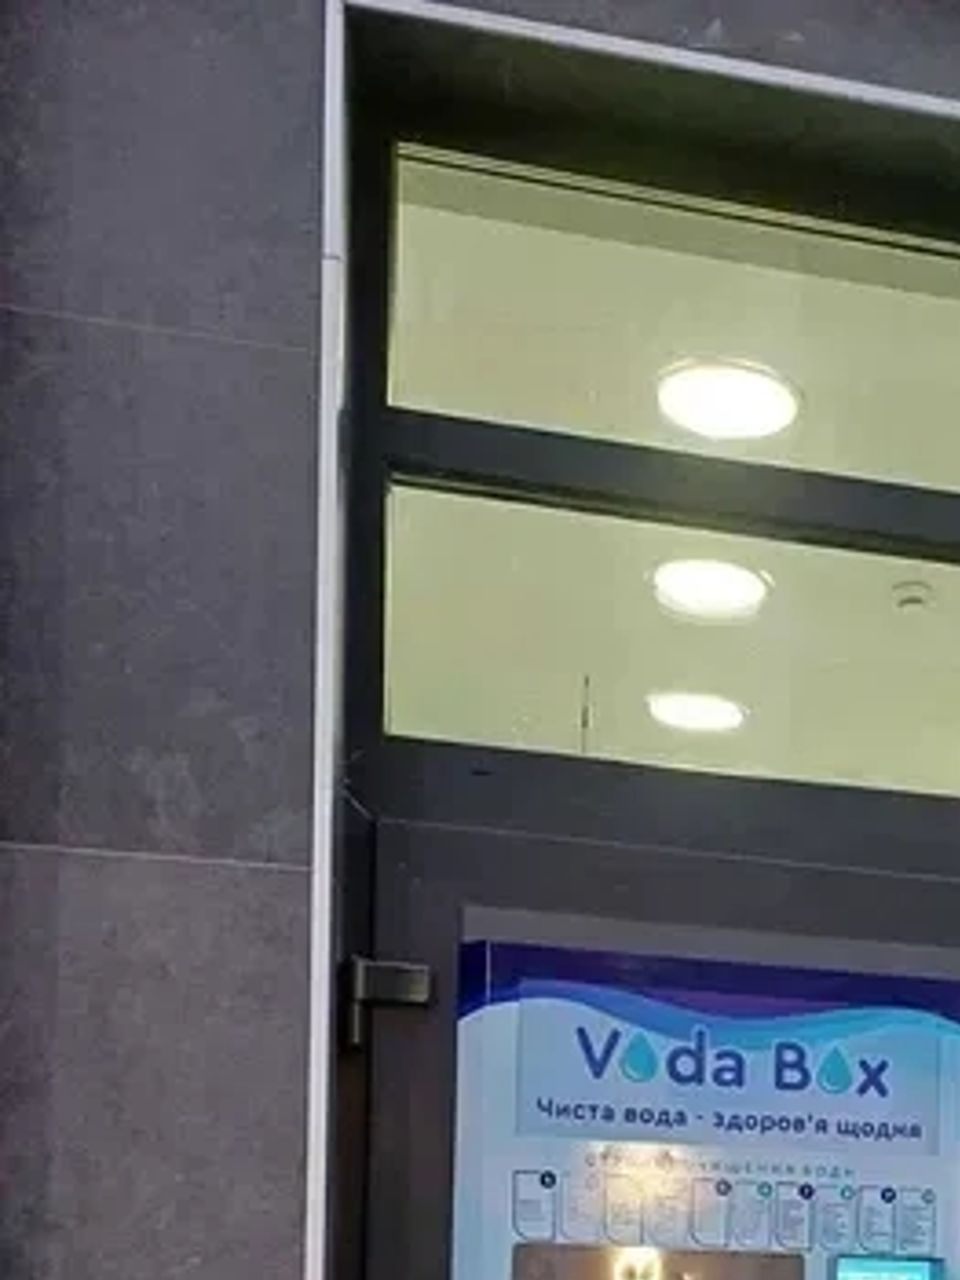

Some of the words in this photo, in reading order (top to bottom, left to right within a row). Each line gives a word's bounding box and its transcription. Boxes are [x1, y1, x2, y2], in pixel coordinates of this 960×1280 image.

[536, 1097, 615, 1122] Чиста
[625, 1106, 688, 1129] вода
[712, 1110, 829, 1136] здоров'я
